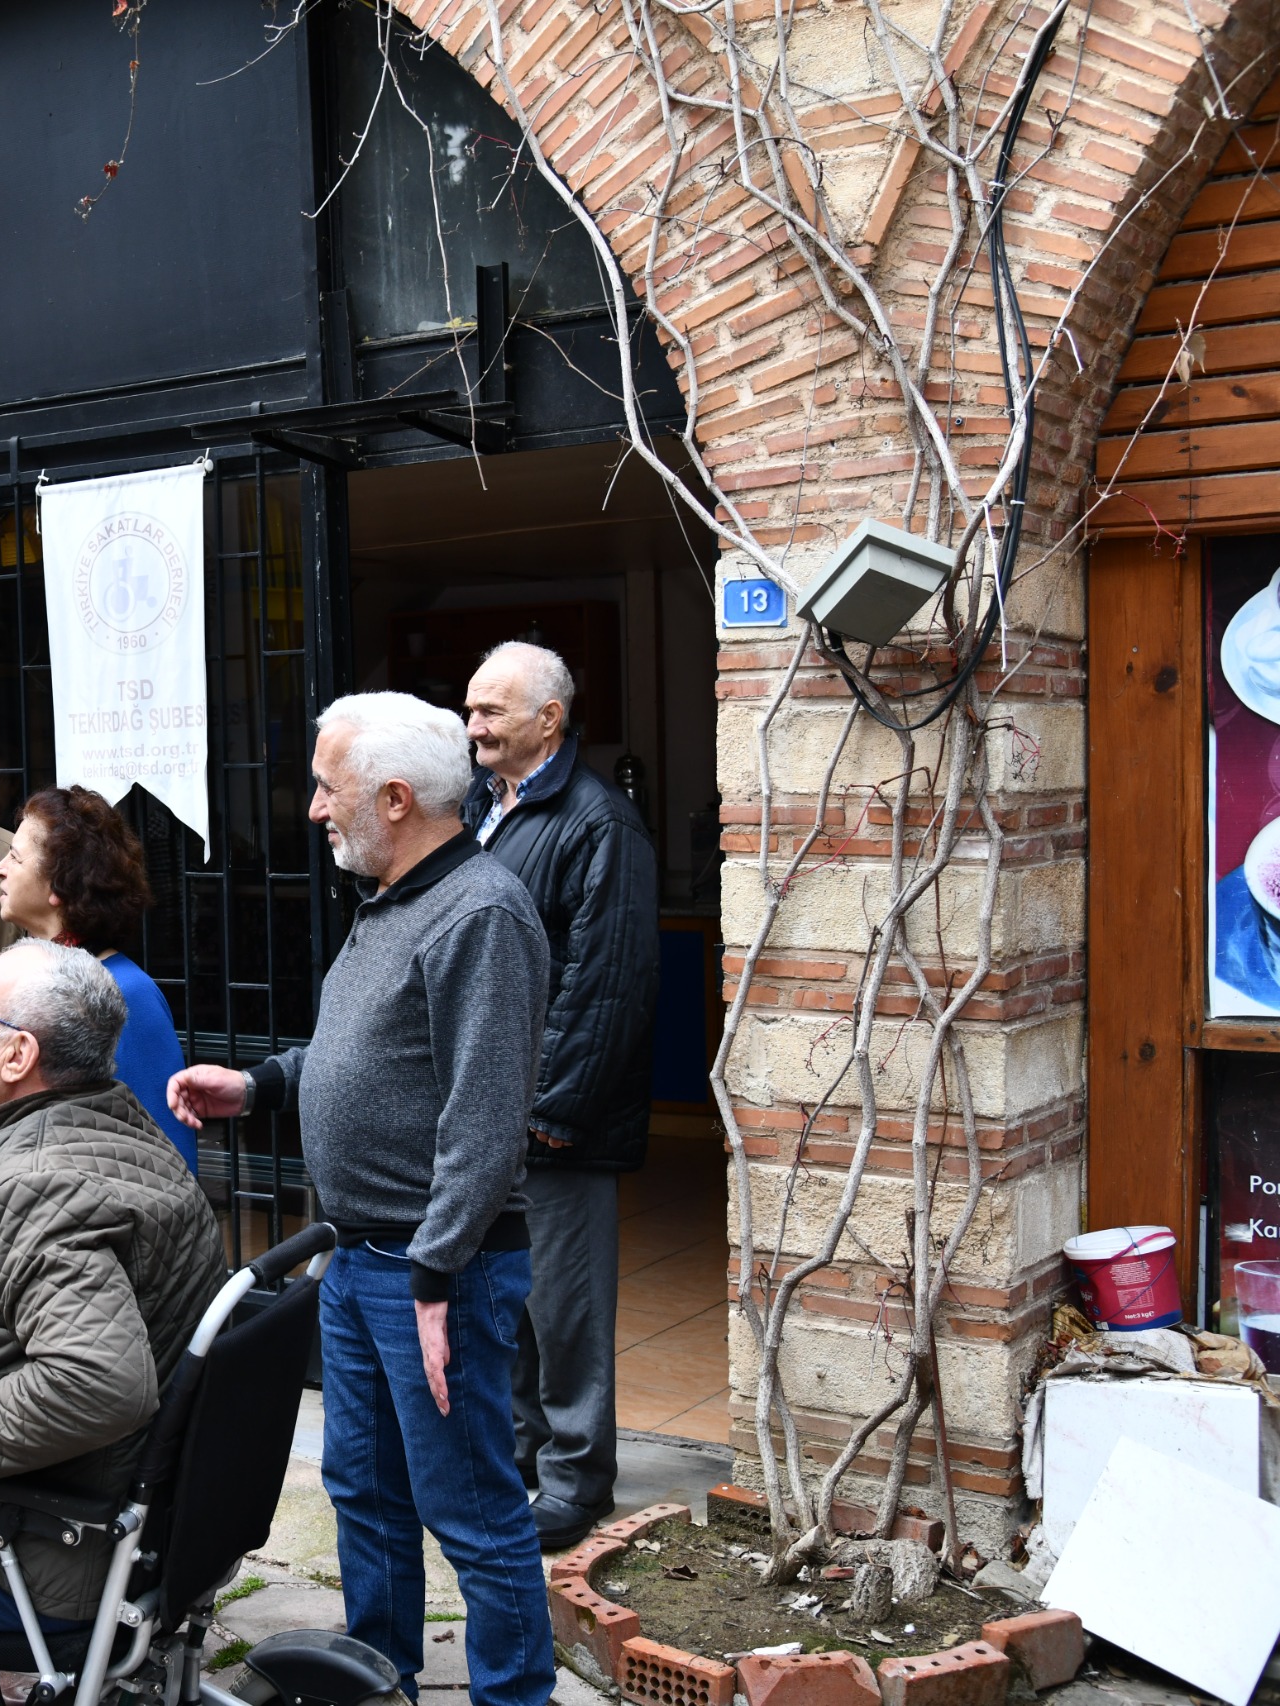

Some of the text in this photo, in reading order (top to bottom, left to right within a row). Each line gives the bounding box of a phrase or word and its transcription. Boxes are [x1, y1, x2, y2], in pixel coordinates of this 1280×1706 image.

[75, 518, 184, 633] TÜRKİYE SAKATLAR DERNEĞİ
[740, 588, 768, 613] 13
[117, 634, 147, 650] 1960
[117, 679, 154, 701] TSD
[69, 703, 143, 735] TEKİRDAĞ
[82, 741, 199, 761] www.tsd.org.tr
[82, 760, 200, 780] tekirdag@tsd.org.tr
[1249, 1218, 1280, 1238] Ka
